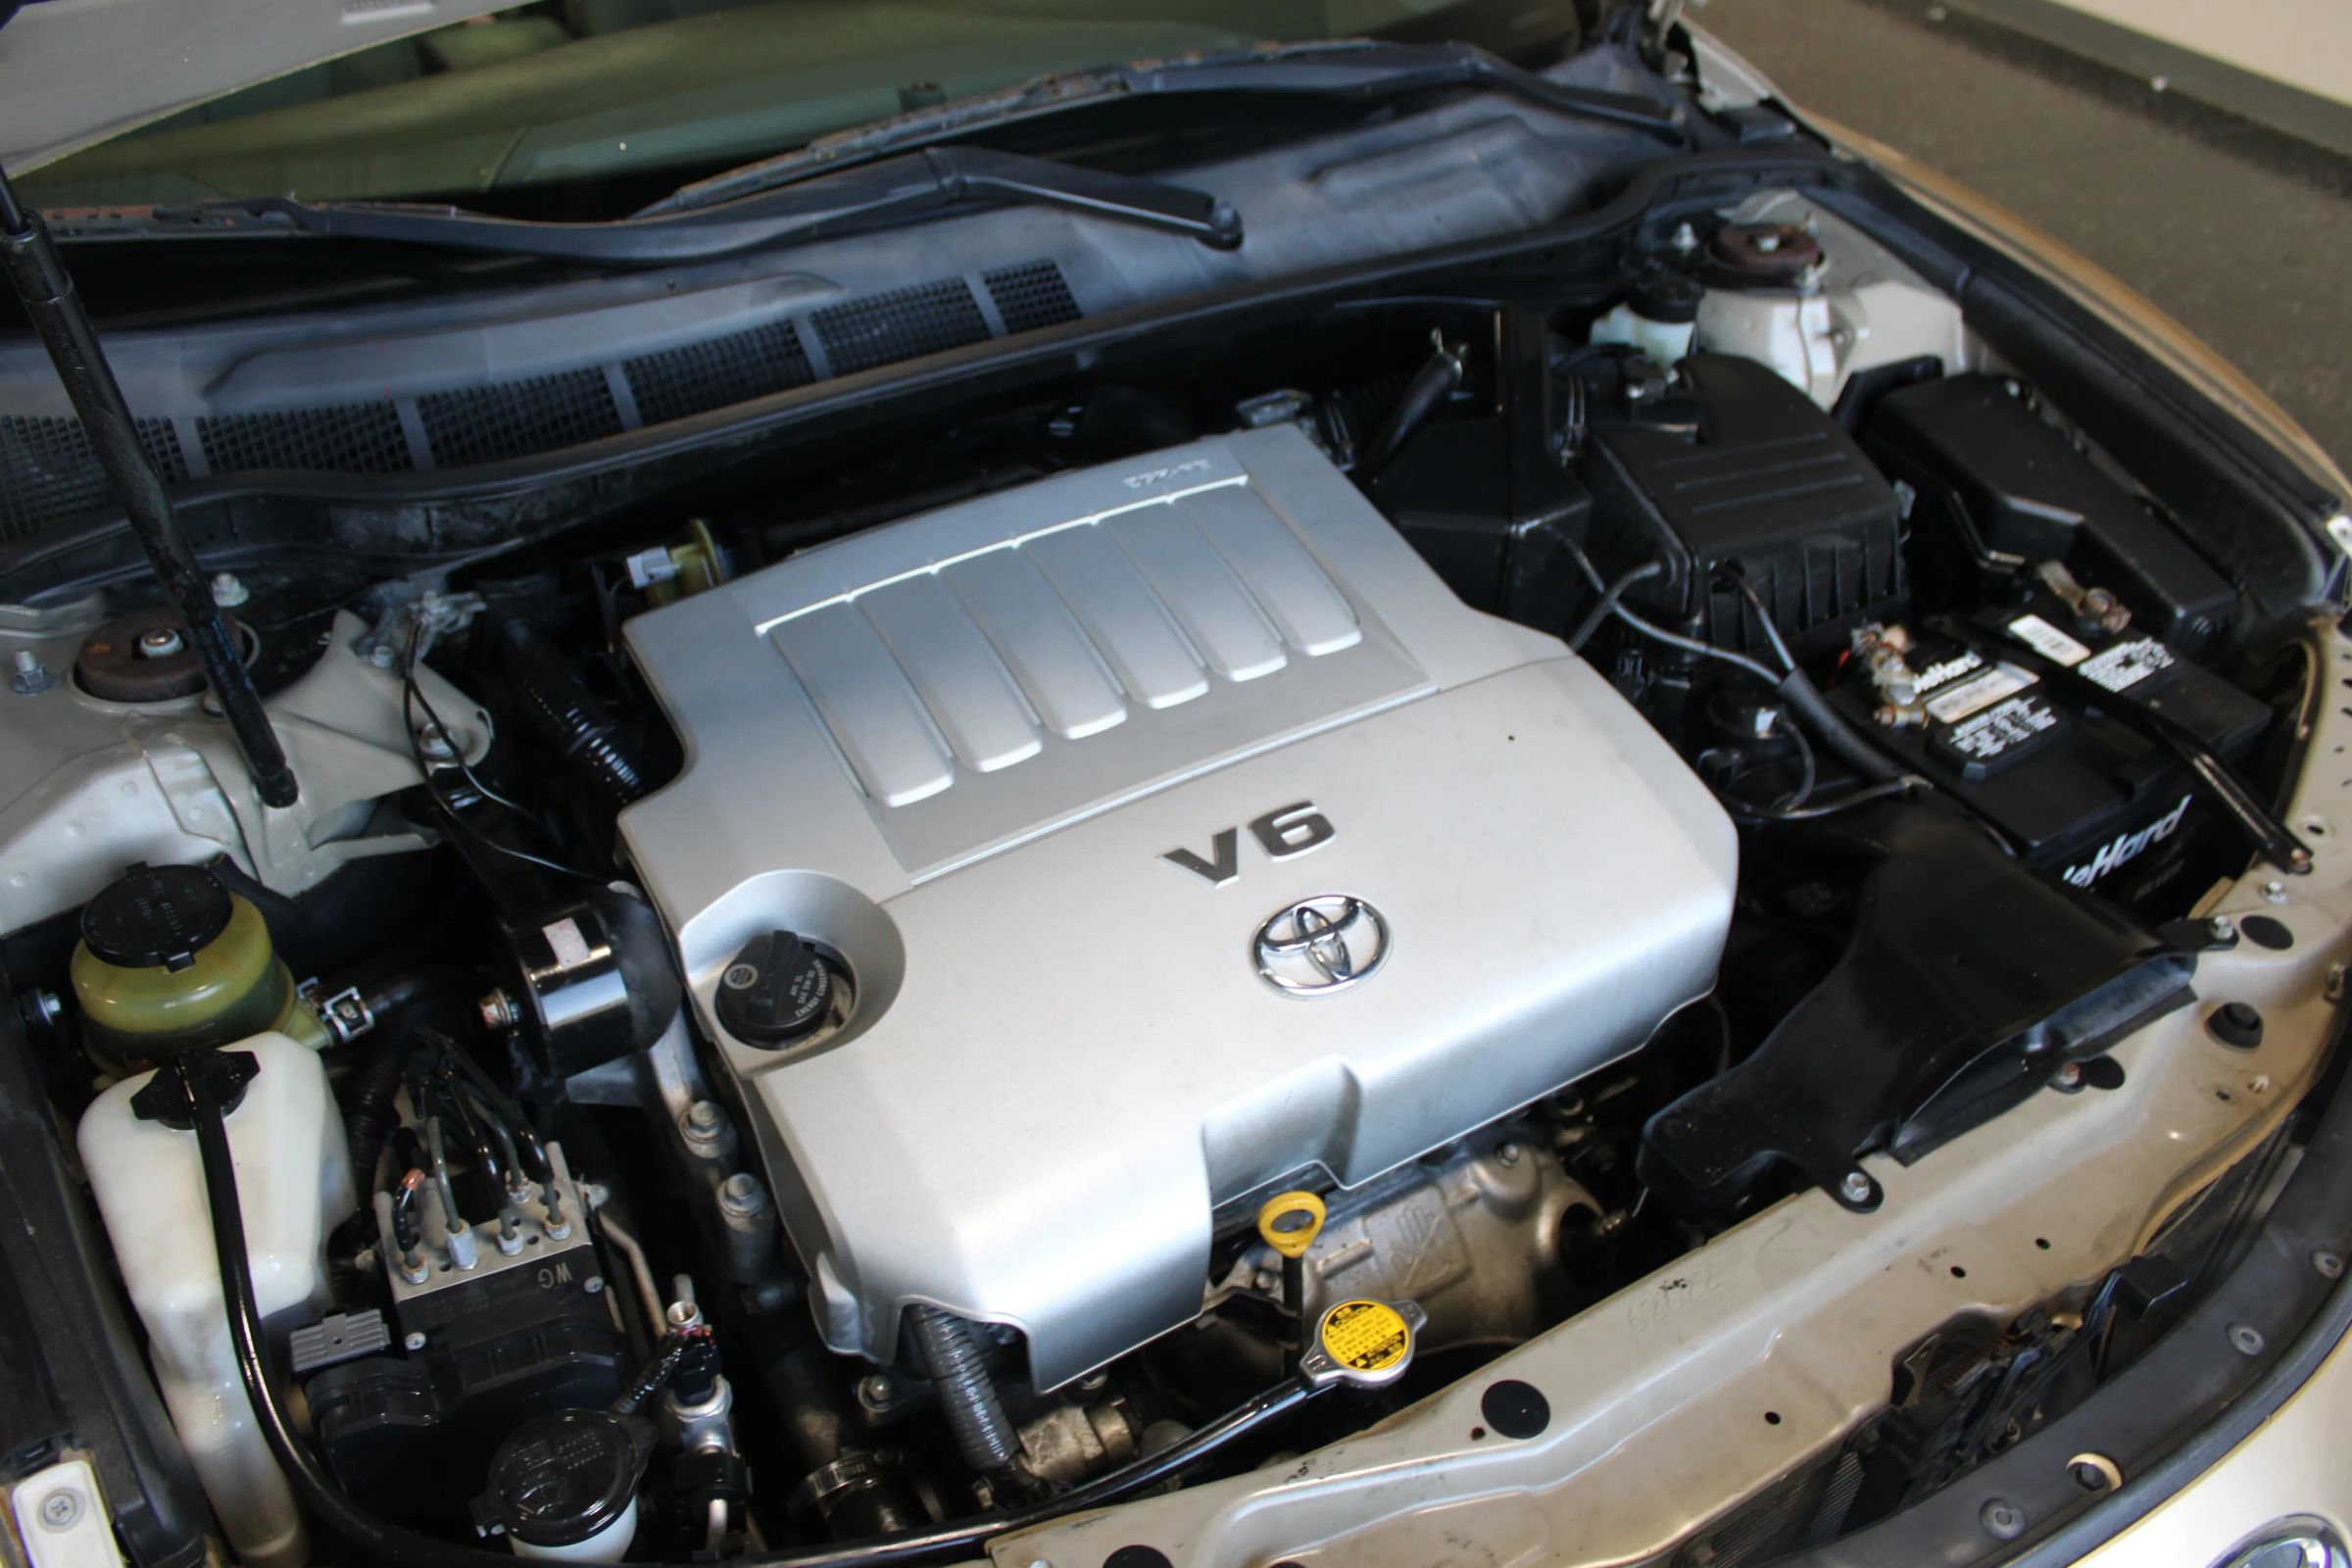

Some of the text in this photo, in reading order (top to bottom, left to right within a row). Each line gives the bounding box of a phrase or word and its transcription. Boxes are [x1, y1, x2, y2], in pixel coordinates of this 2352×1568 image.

[1155, 800, 1337, 890] V6
[795, 997, 820, 1017] ENERGY
[798, 991, 808, 1004] SAE
[537, 1261, 573, 1289] WG
